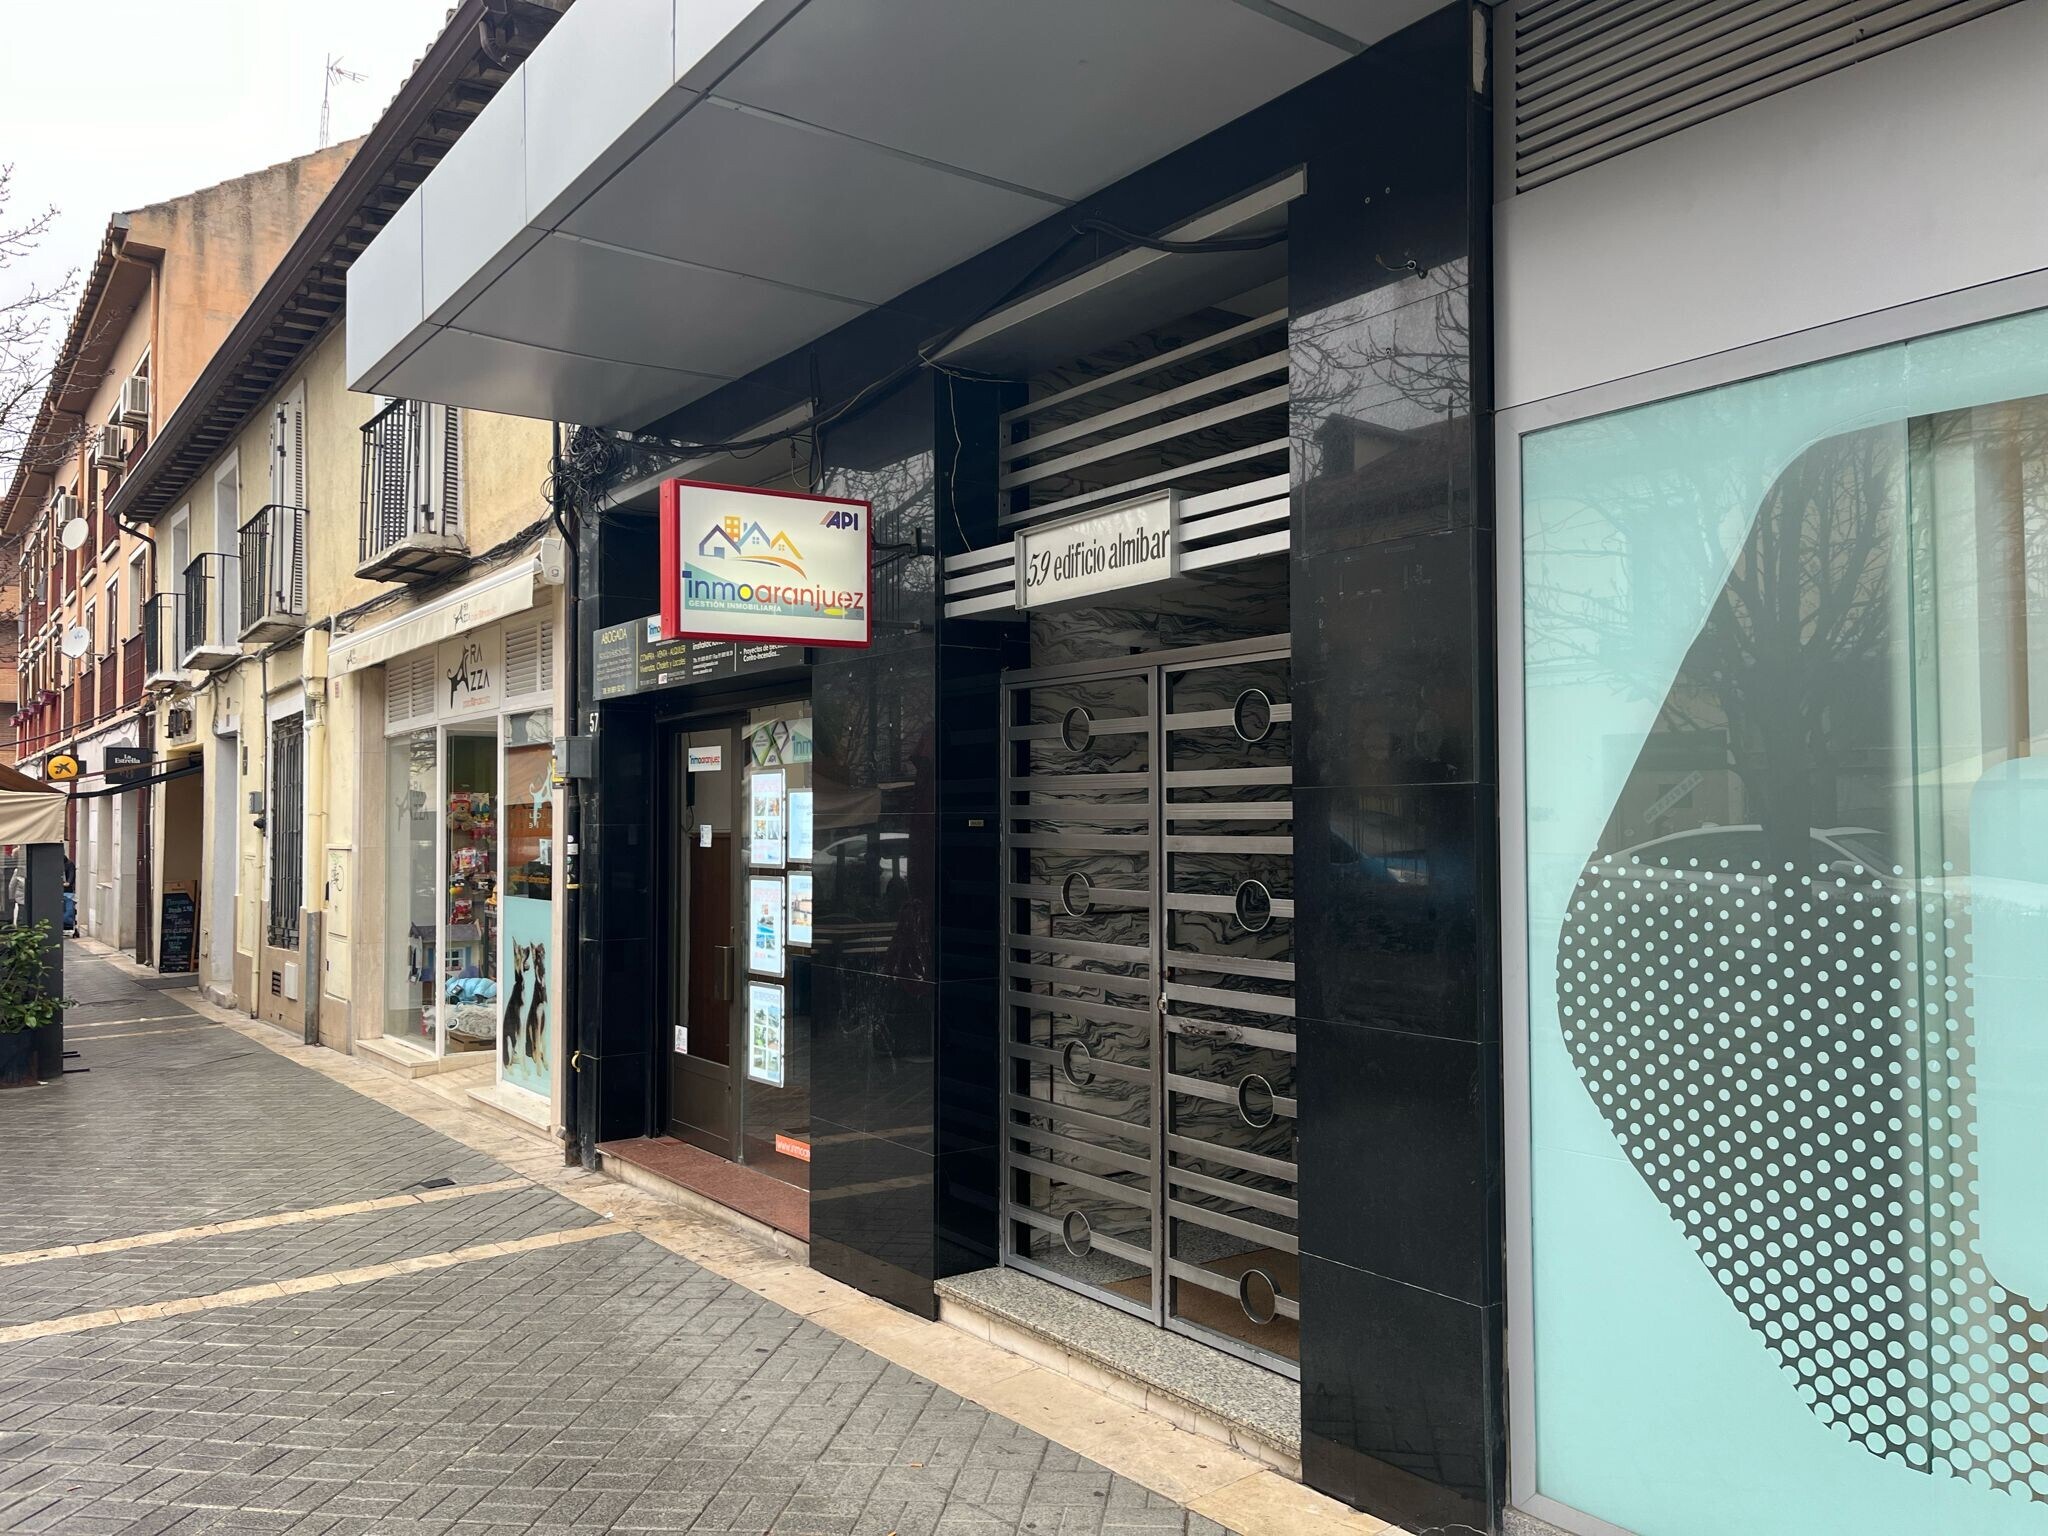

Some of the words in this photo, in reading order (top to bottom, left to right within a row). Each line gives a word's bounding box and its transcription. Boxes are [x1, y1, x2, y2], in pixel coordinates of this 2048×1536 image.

[822, 511, 858, 531] API
[1026, 550, 1051, 587] 59
[1053, 538, 1105, 581] edificio
[1108, 526, 1170, 570] almíbar
[682, 570, 864, 612] inmoaranjuez
[688, 599, 725, 609] GESTIÓN
[601, 628, 628, 645] ABOGADA
[589, 712, 599, 733] 57
